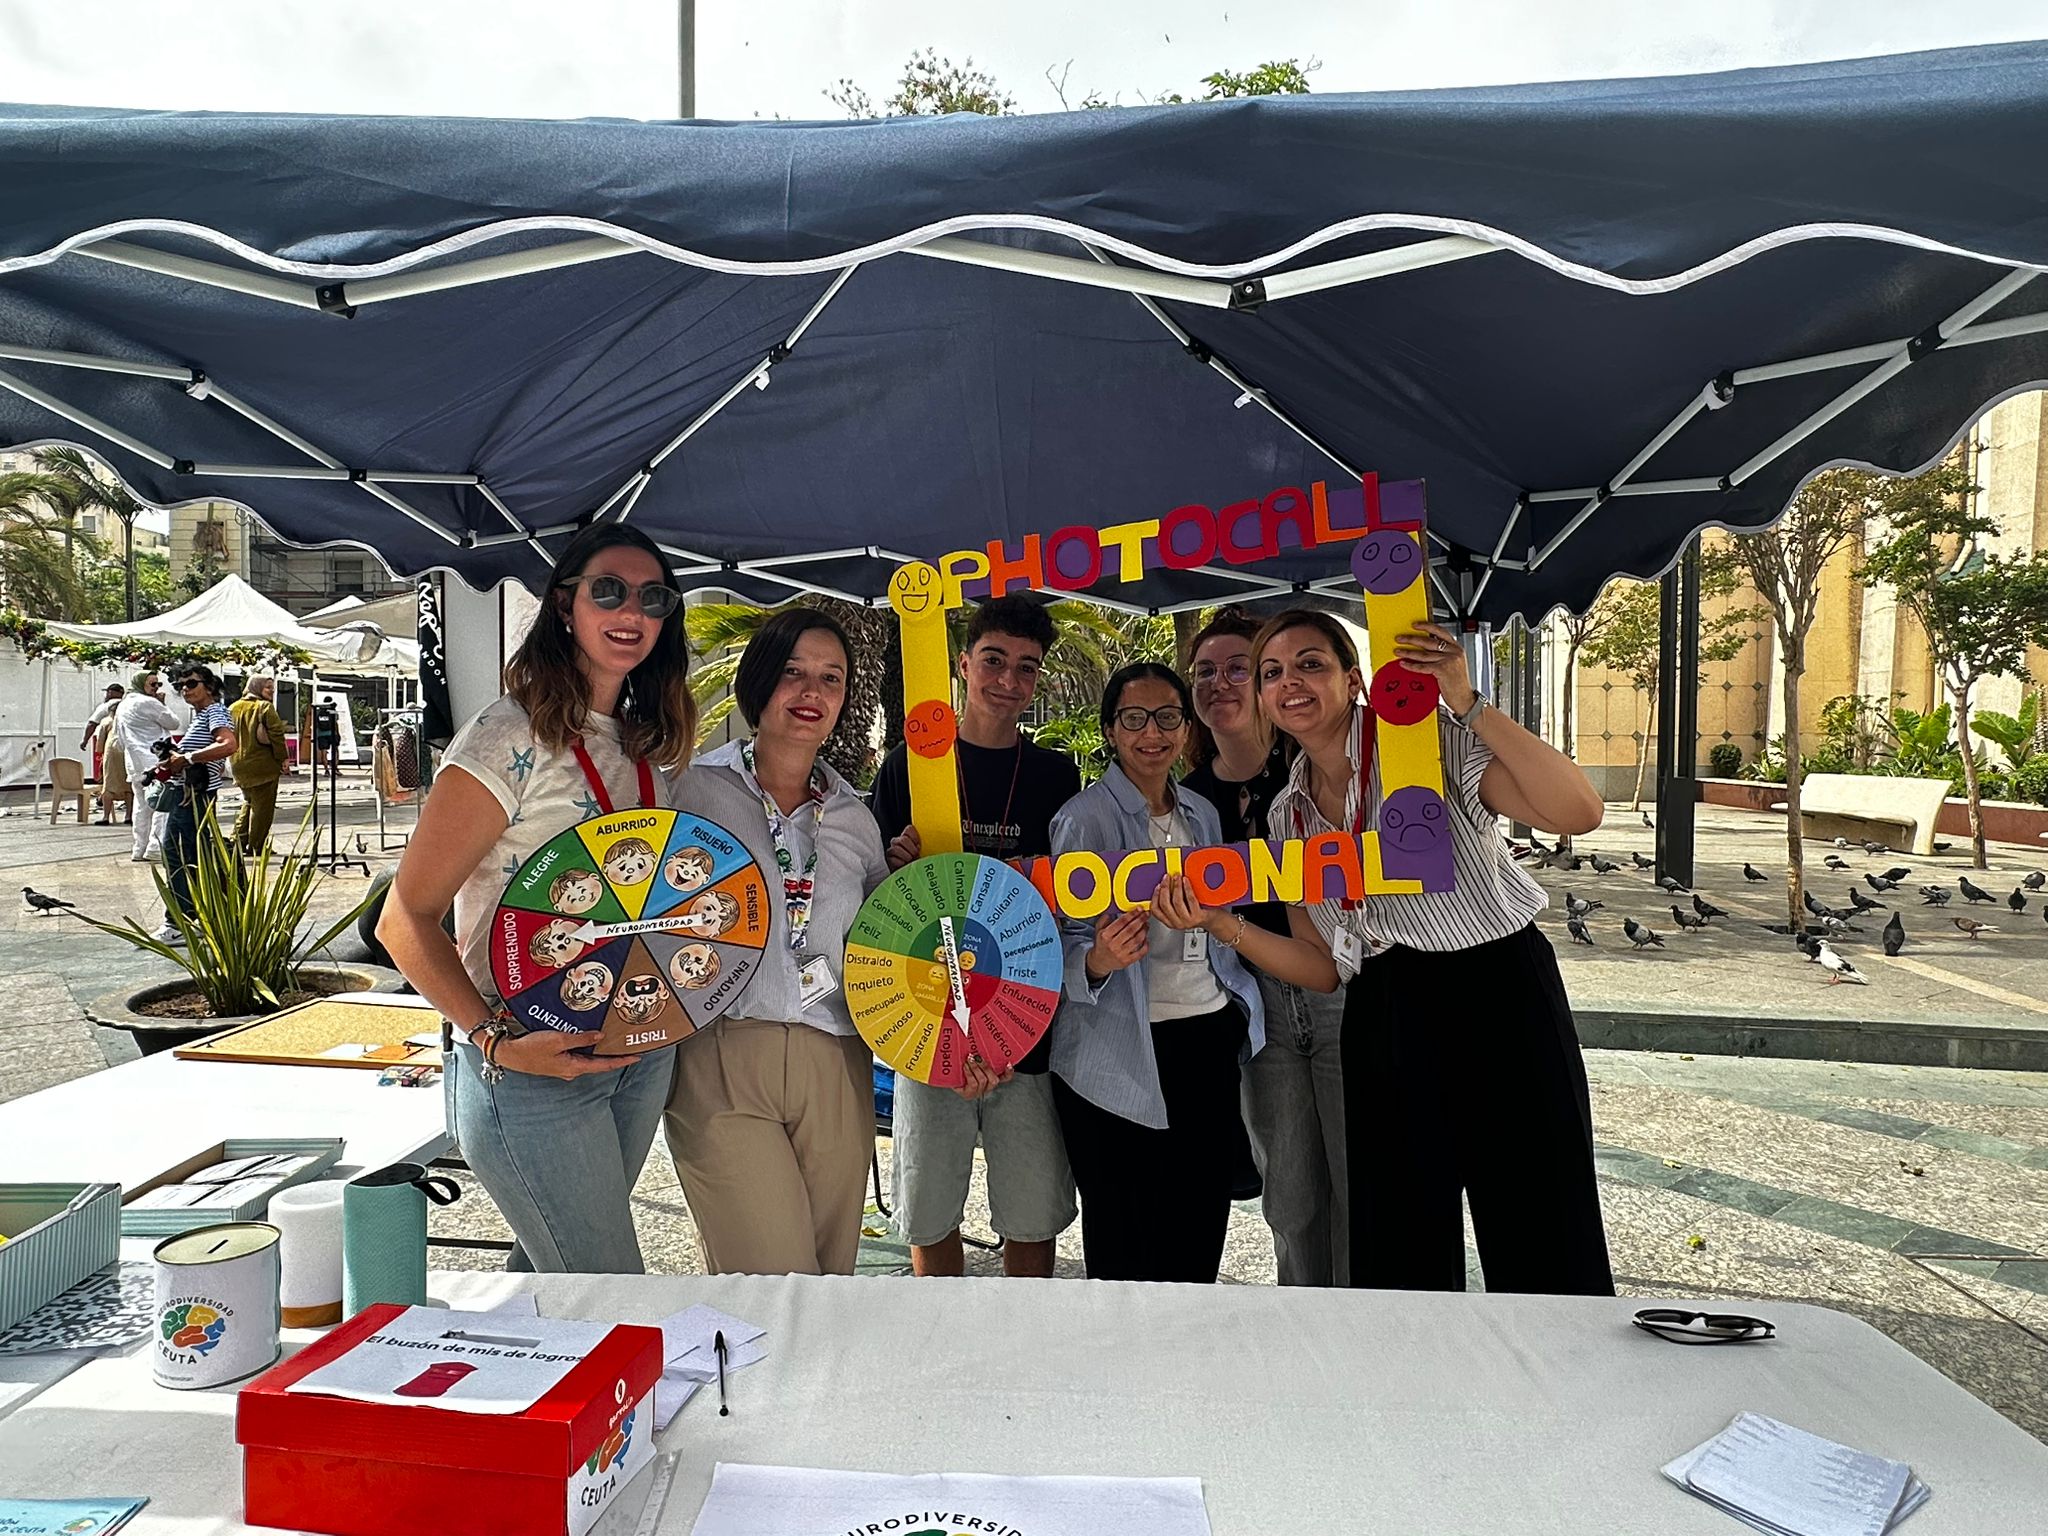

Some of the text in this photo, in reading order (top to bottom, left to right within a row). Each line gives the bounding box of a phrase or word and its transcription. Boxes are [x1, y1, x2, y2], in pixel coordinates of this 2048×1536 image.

[938, 472, 1422, 609] PHOTOCALL
[596, 817, 657, 836] ABURRIDO
[690, 826, 734, 856] RISUEÑO
[962, 819, 1021, 837] Unexplored
[521, 849, 560, 890] ALEGRE
[953, 860, 965, 910] Calmado
[1005, 831, 1423, 918] MOCONAL
[895, 877, 928, 923] Enfocado
[924, 863, 945, 910] Relajado
[971, 867, 996, 914] Cansado
[745, 883, 759, 933] SENSIBLE
[871, 898, 914, 933] Controlado
[987, 886, 1020, 926] Solitario
[606, 918, 694, 935] NEURODIVERSIDAD
[858, 921, 882, 940] Feliz
[963, 934, 982, 943] ZONA
[1000, 910, 1042, 942] Aburrido
[503, 912, 523, 991] SORPRENDIDO
[1004, 936, 1054, 959] Decepcionado
[703, 960, 750, 1012] ENFADADO
[848, 977, 894, 992] Inquieto
[1007, 966, 1037, 979] Triste
[855, 992, 905, 1019] Preocupado
[1002, 984, 1051, 1015] Enfurecido
[528, 1004, 583, 1035] ONTENTO
[875, 1011, 914, 1047] Nervioso
[994, 997, 1036, 1037] Inconsolable
[625, 1029, 668, 1046] TRISTE
[905, 1023, 934, 1071] Frustrado
[981, 1012, 1012, 1057] Histérico
[942, 1028, 953, 1076] Enojado
[158, 1340, 197, 1364] CEUTA
[366, 1335, 585, 1363] El buzón de mis de logros
[581, 1475, 616, 1507] CEUTA
